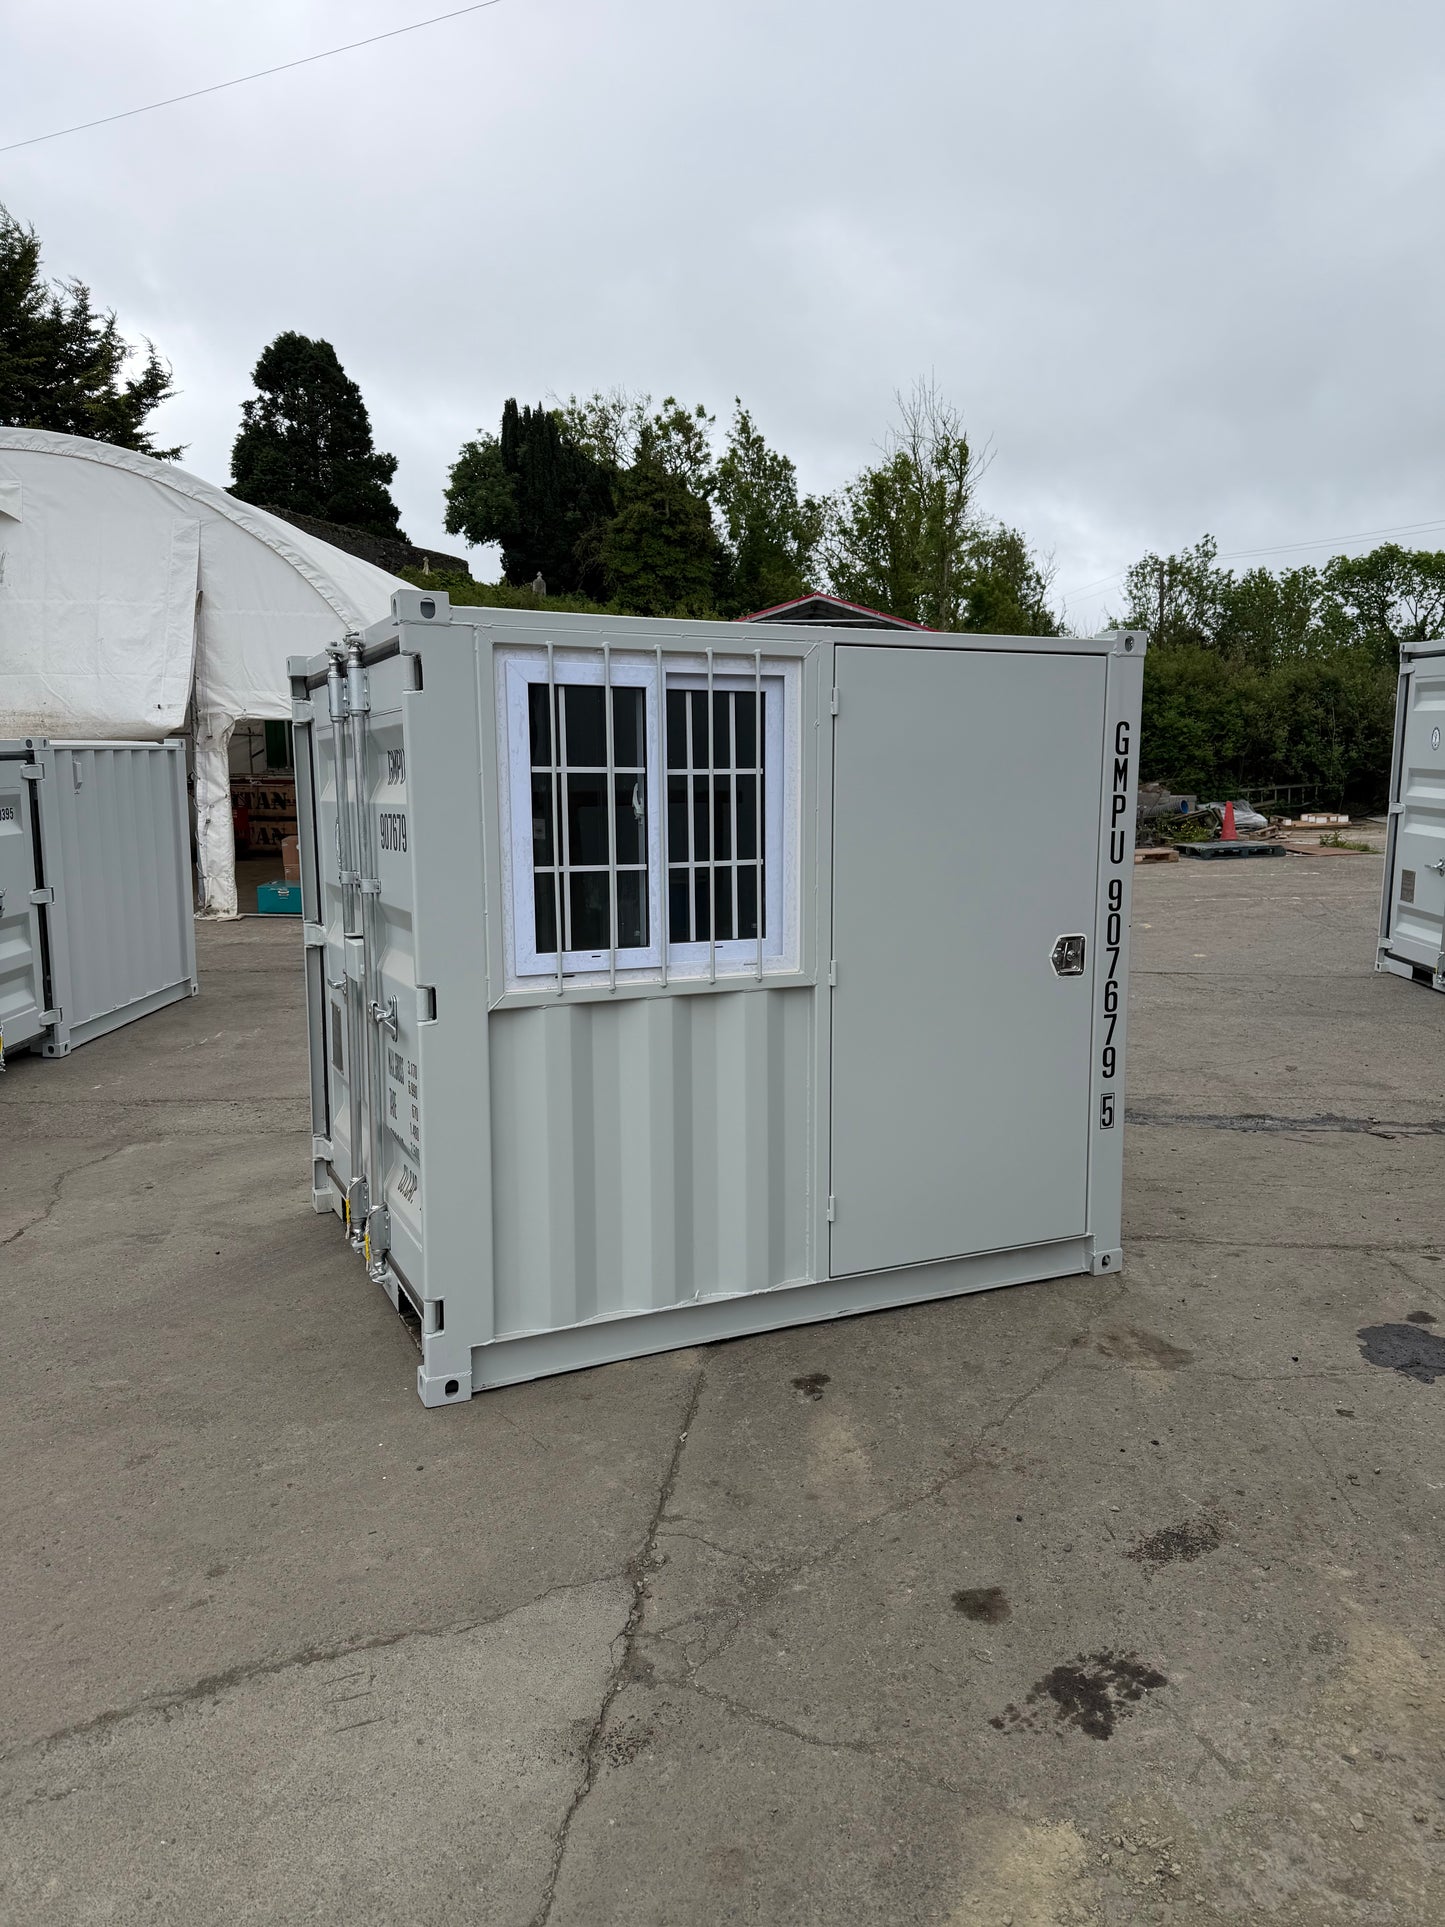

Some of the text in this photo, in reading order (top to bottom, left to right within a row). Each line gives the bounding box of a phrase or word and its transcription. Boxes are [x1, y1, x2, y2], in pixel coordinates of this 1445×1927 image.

[0, 807, 14, 821] 395
[380, 813, 407, 852] 907679
[1101, 720, 1131, 1130] GMPU 907679 5
